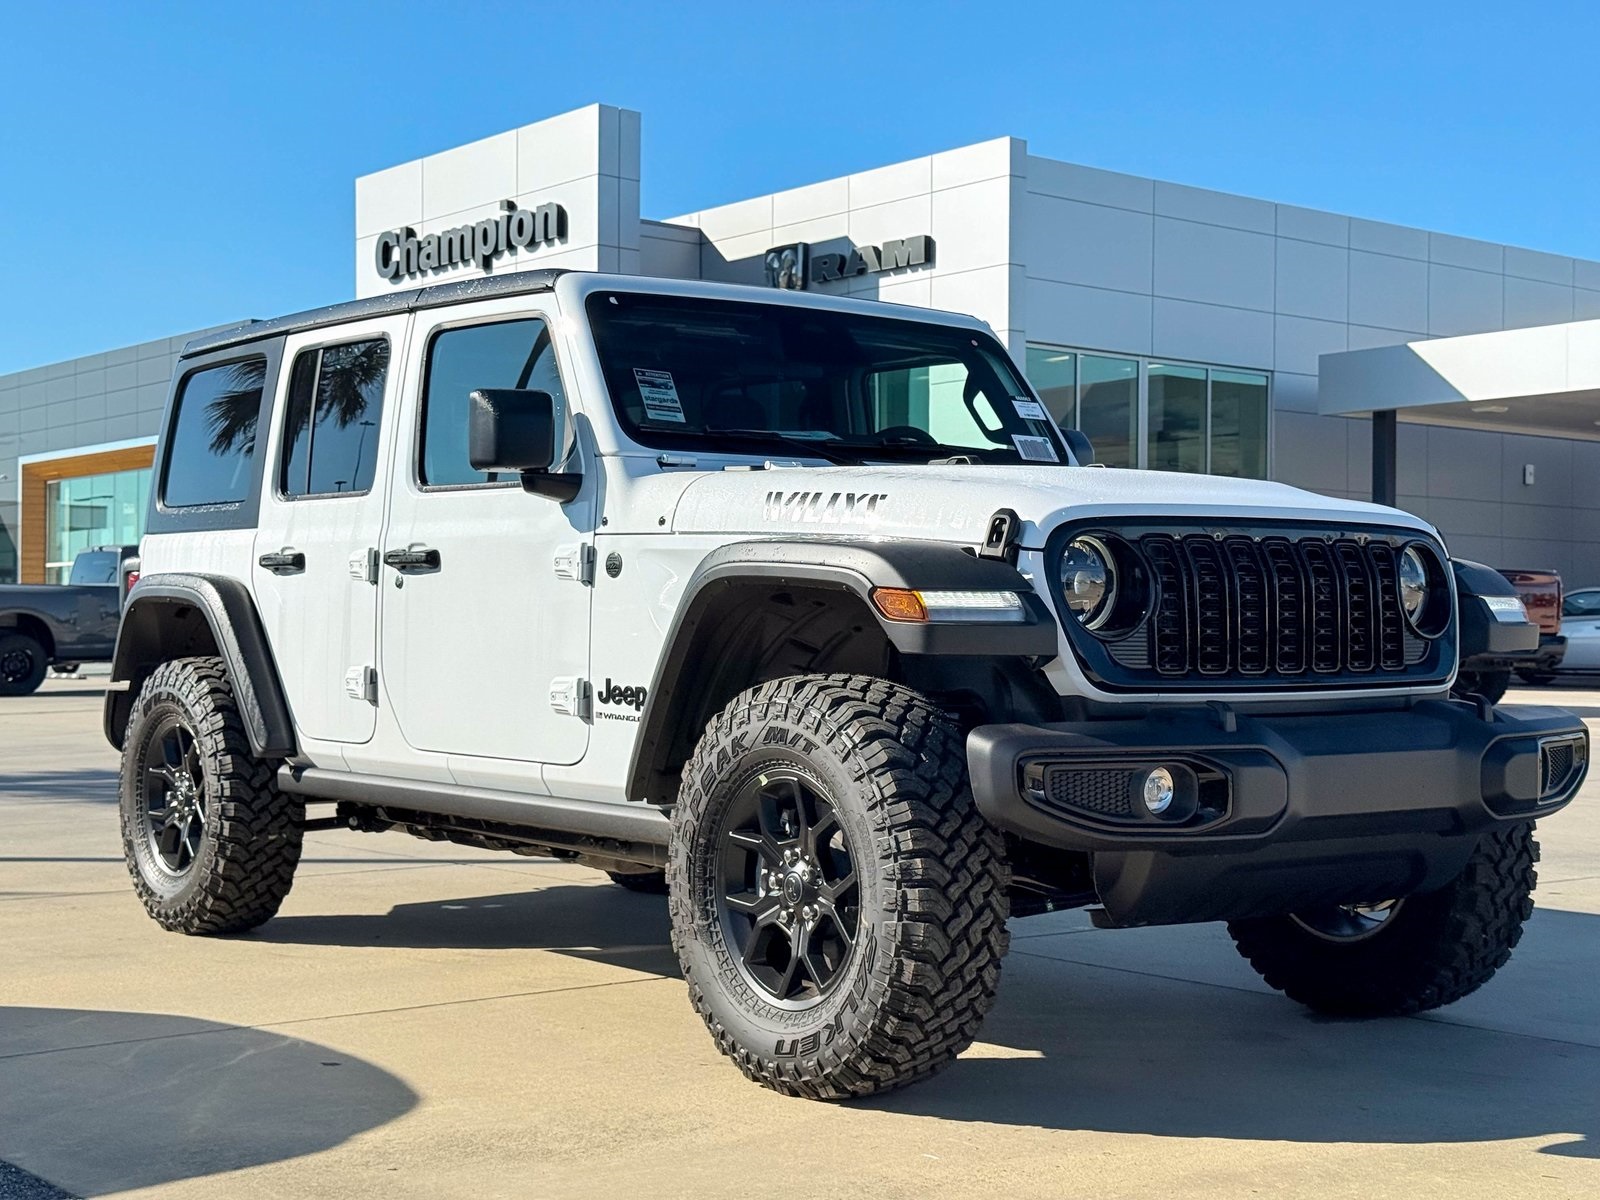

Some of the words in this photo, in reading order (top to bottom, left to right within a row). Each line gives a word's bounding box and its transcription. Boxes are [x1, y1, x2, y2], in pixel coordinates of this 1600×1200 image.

[375, 198, 566, 281] Champion
[812, 235, 931, 283] RAM
[598, 678, 648, 712] Jeep
[763, 726, 820, 755] M/T
[774, 924, 878, 1060] FALKEN
